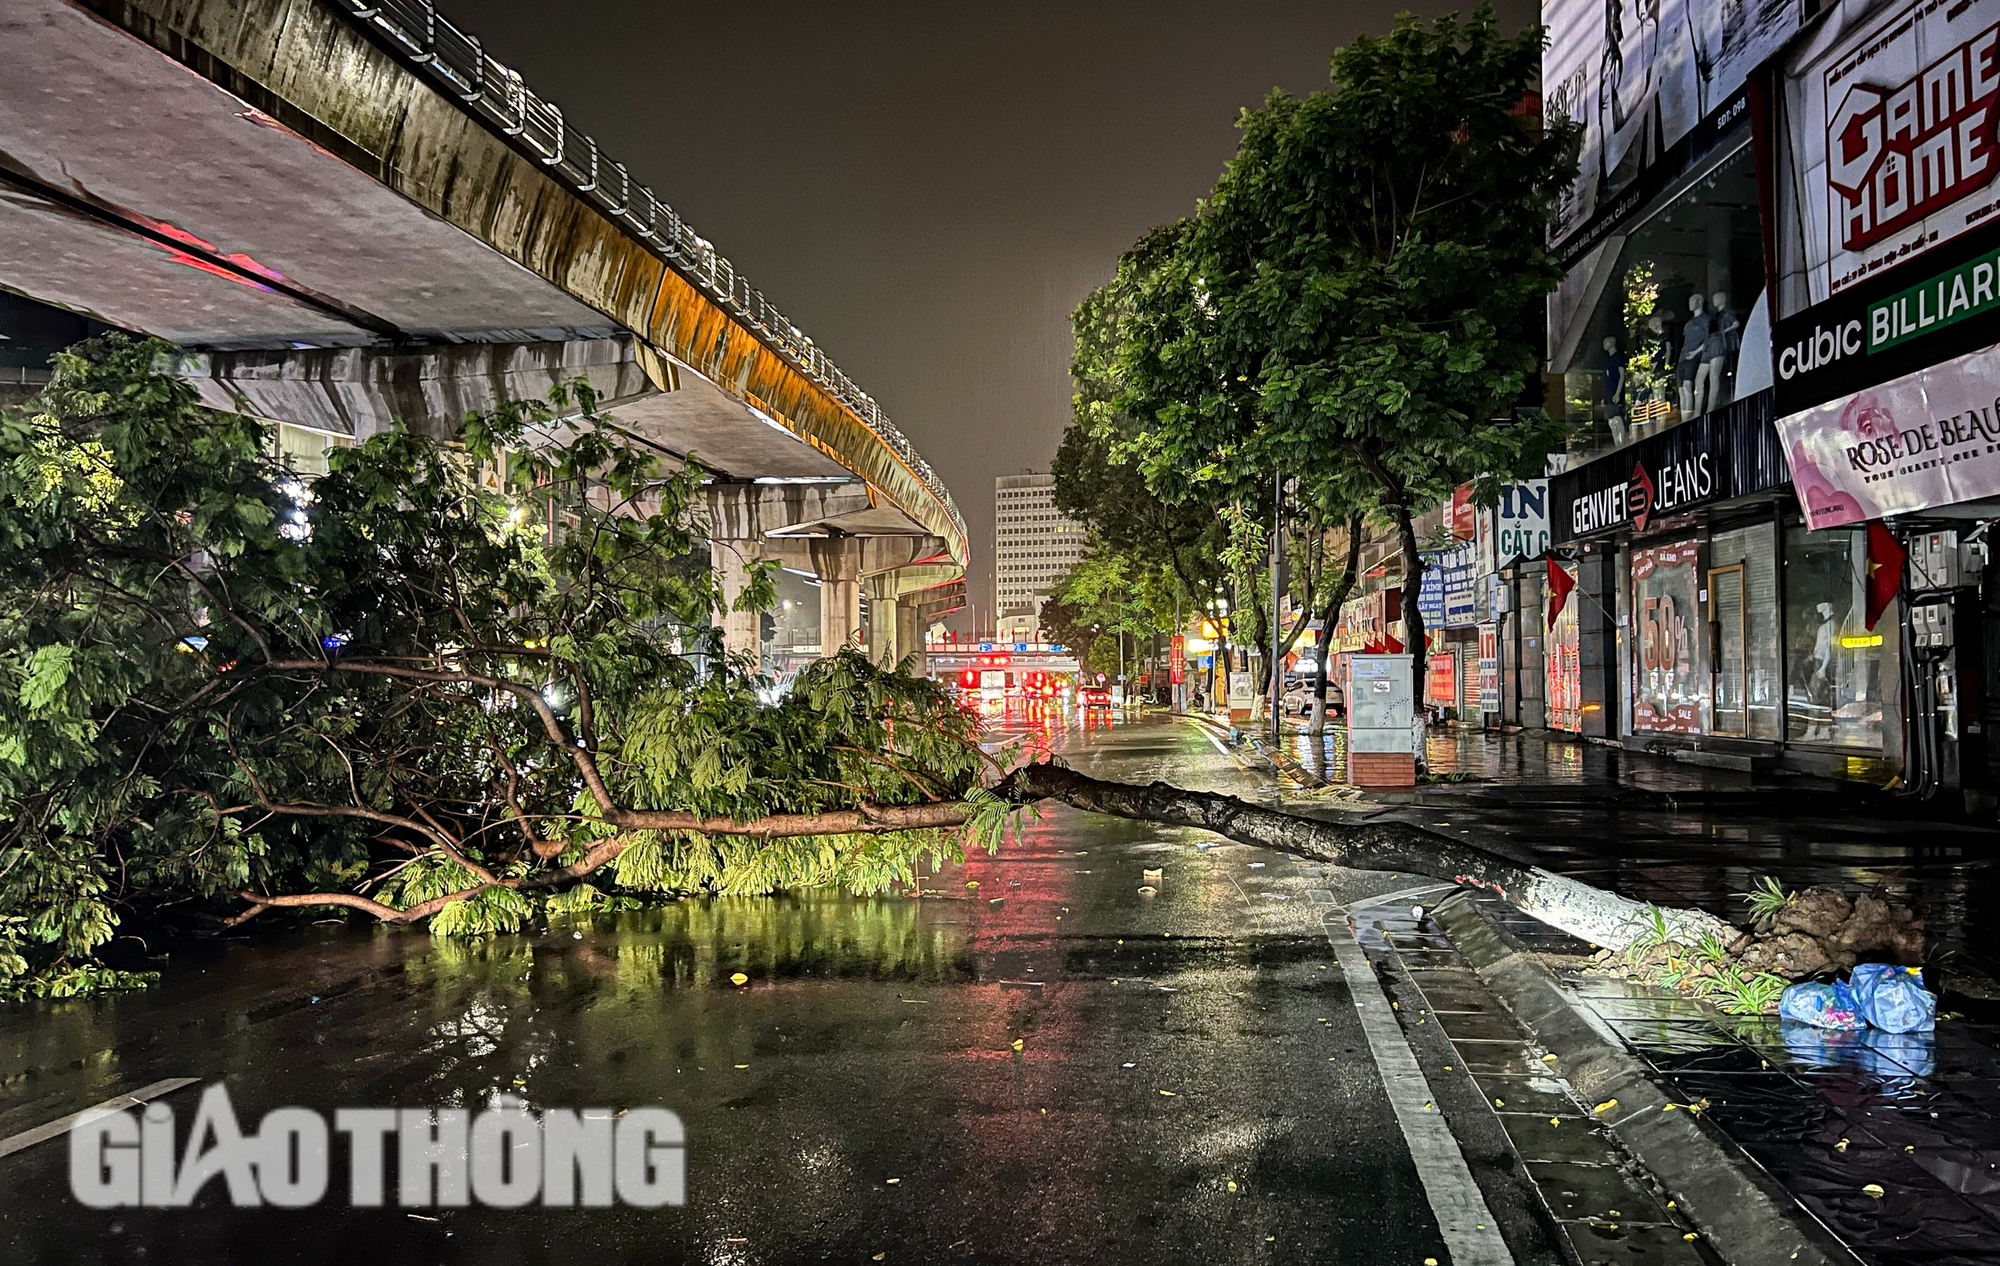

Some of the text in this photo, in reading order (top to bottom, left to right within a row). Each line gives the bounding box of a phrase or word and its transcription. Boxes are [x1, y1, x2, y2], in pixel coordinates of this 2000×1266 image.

[1829, 27, 2000, 191] GAME
[1842, 106, 1989, 244] HOME
[1872, 254, 2000, 346] BILLIAR
[1846, 434, 1904, 473] ROSE
[1899, 424, 1939, 456] DE
[1501, 484, 1547, 520] IN
[1573, 452, 1712, 534] GENVIET JEANS
[1502, 520, 1532, 556] CẮT
[1480, 633, 1496, 659] in
[1678, 708, 1692, 720] SALE
